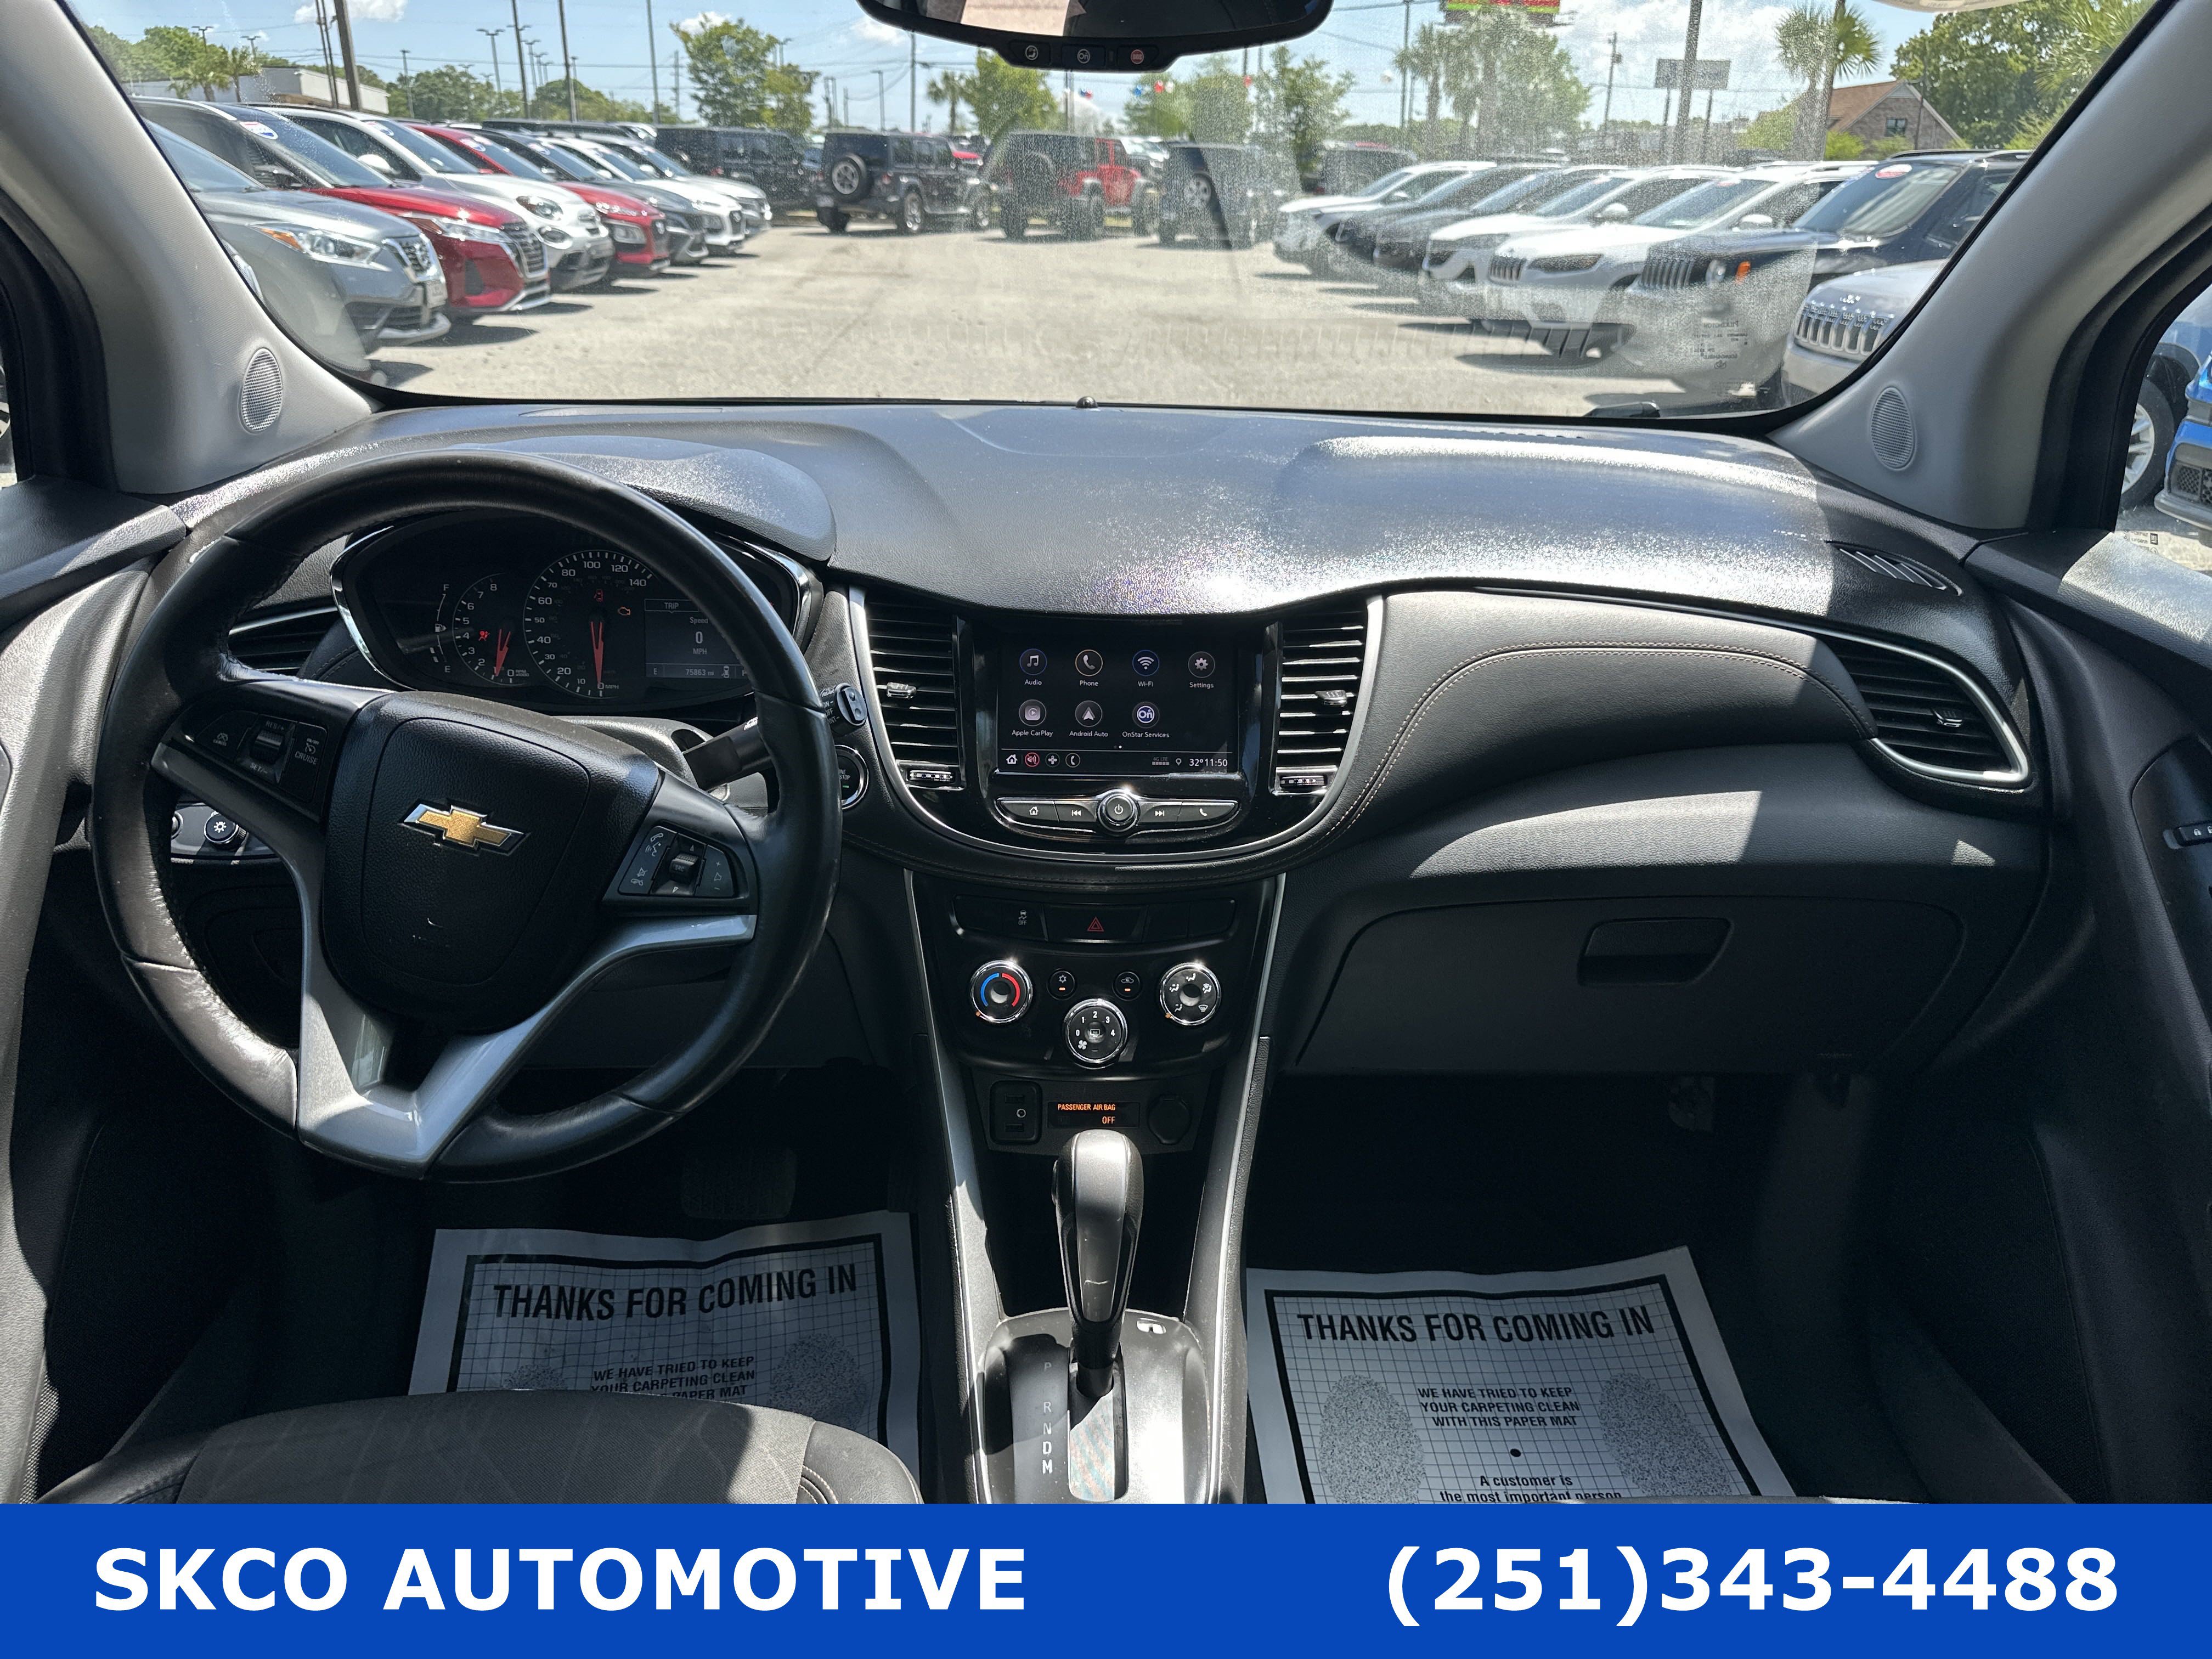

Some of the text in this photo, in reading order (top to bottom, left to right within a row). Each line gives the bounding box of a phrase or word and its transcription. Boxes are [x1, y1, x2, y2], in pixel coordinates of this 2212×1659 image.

[611, 565, 628, 573] 120
[538, 597, 552, 605] 60
[690, 617, 708, 625] Speed
[695, 631, 703, 644] 0
[1138, 709, 1153, 719] On
[1030, 730, 1053, 738] CarPlay
[295, 751, 319, 765] CRUISE
[1205, 758, 1228, 766] 11:50
[1102, 1116, 1115, 1124] OFF
[493, 1263, 857, 1322] THANKS FOR COMING IN
[1297, 1306, 1655, 1344] THANKS FOR COMING IN
[594, 1356, 754, 1381] WE HAVE TRIED TO KEEP
[1044, 1362, 1052, 1370] P
[633, 1374, 708, 1392] CARPETING
[713, 1370, 755, 1384] CLEAN
[719, 1385, 747, 1398] MAT
[1418, 1387, 1572, 1399] WE HAVE TRIED TO KEEP
[1043, 1401, 1052, 1414] R
[1420, 1401, 1581, 1413] YOUR CARPETING CLEAN
[1432, 1415, 1578, 1427] WITH THIS PAPER MAT
[1043, 1421, 1052, 1435] N
[1042, 1441, 1052, 1455] D
[1042, 1459, 1053, 1475] M
[1480, 1475, 1573, 1486] A customer is
[1440, 1491, 1462, 1502] the
[1466, 1491, 1499, 1503] most
[1504, 1491, 1571, 1504] important
